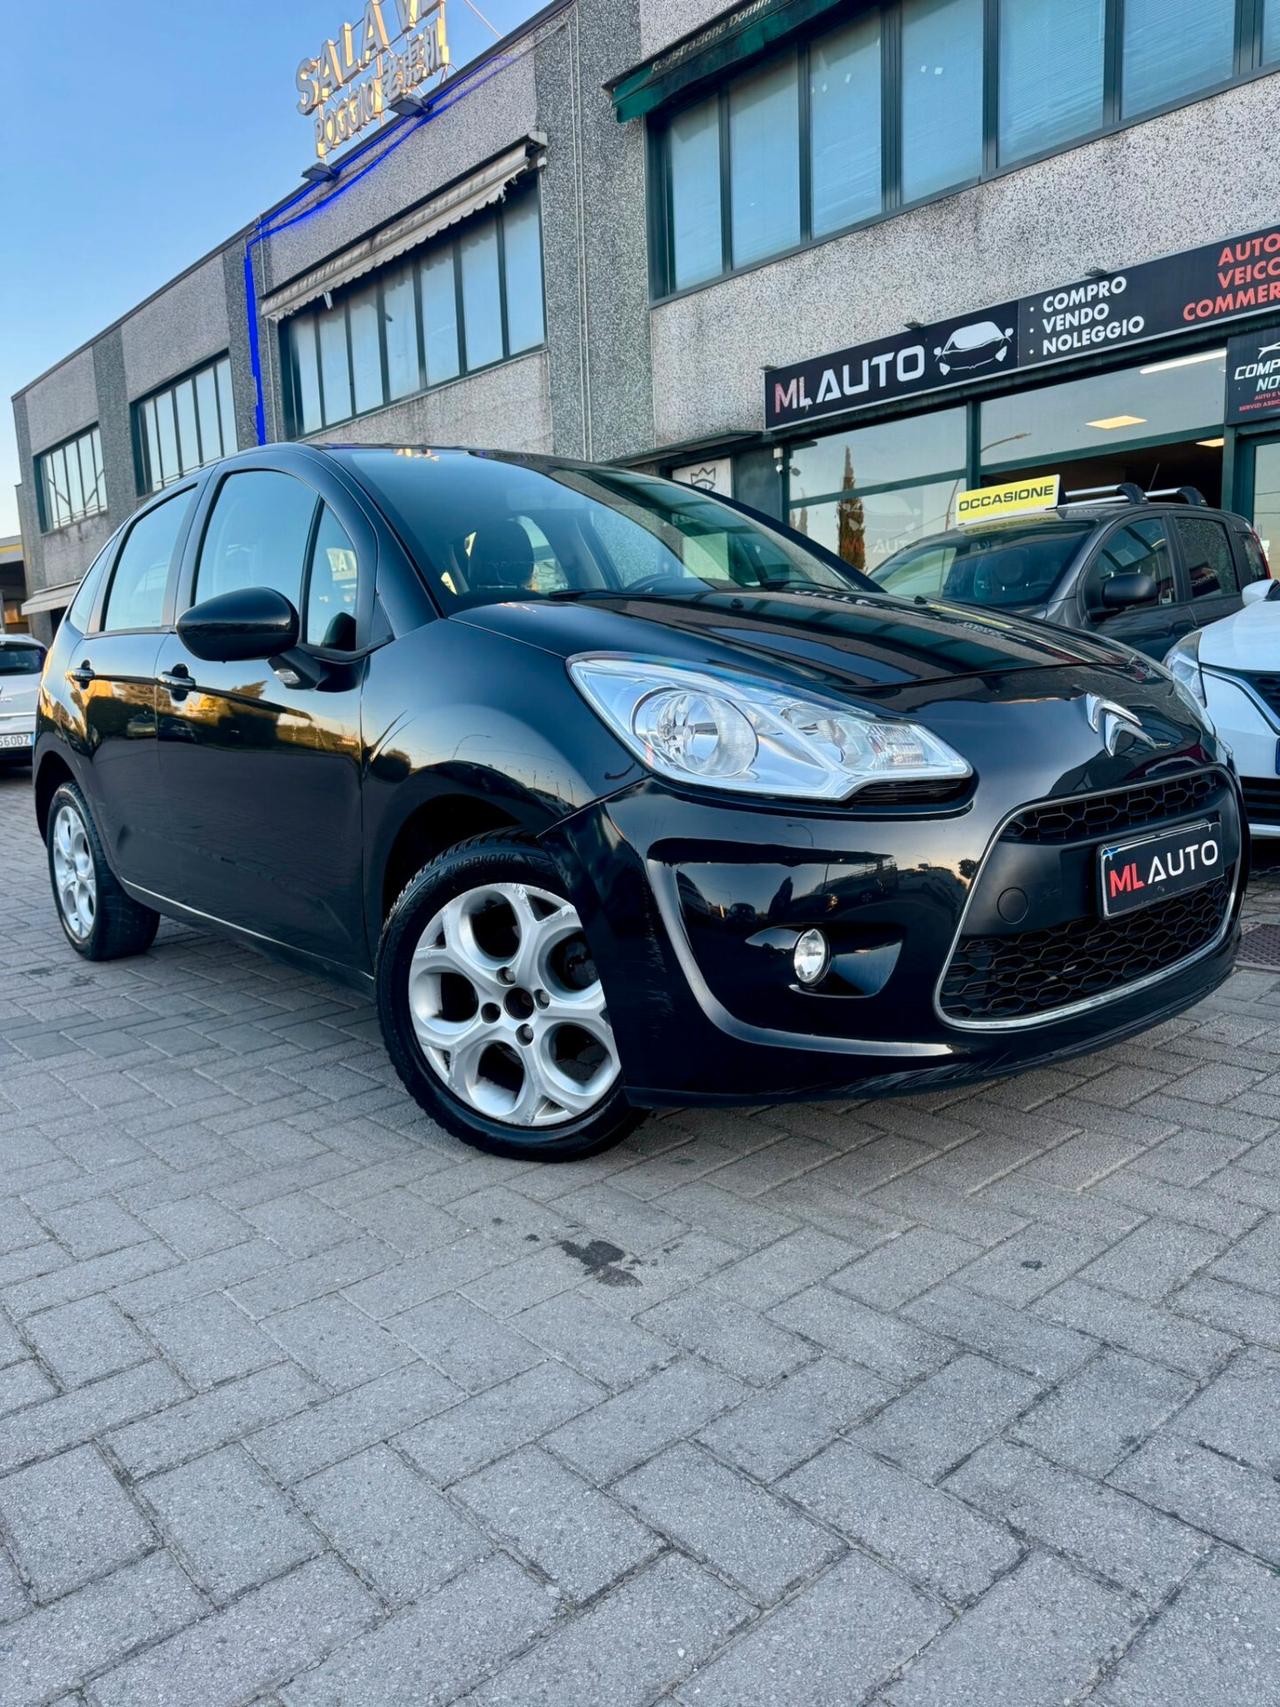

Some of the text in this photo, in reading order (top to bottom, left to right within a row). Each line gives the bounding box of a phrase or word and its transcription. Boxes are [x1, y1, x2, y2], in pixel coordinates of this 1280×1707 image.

[1217, 233, 1280, 267] AUTO
[1043, 276, 1127, 313] COMPRO
[1183, 281, 1280, 321] COMMER
[1042, 303, 1109, 334] VENDO
[1043, 316, 1144, 355] NOLEGGIO
[816, 345, 925, 404] AUTO
[959, 485, 1054, 511] OCCASIONE
[1110, 840, 1219, 897] ML AUTO
